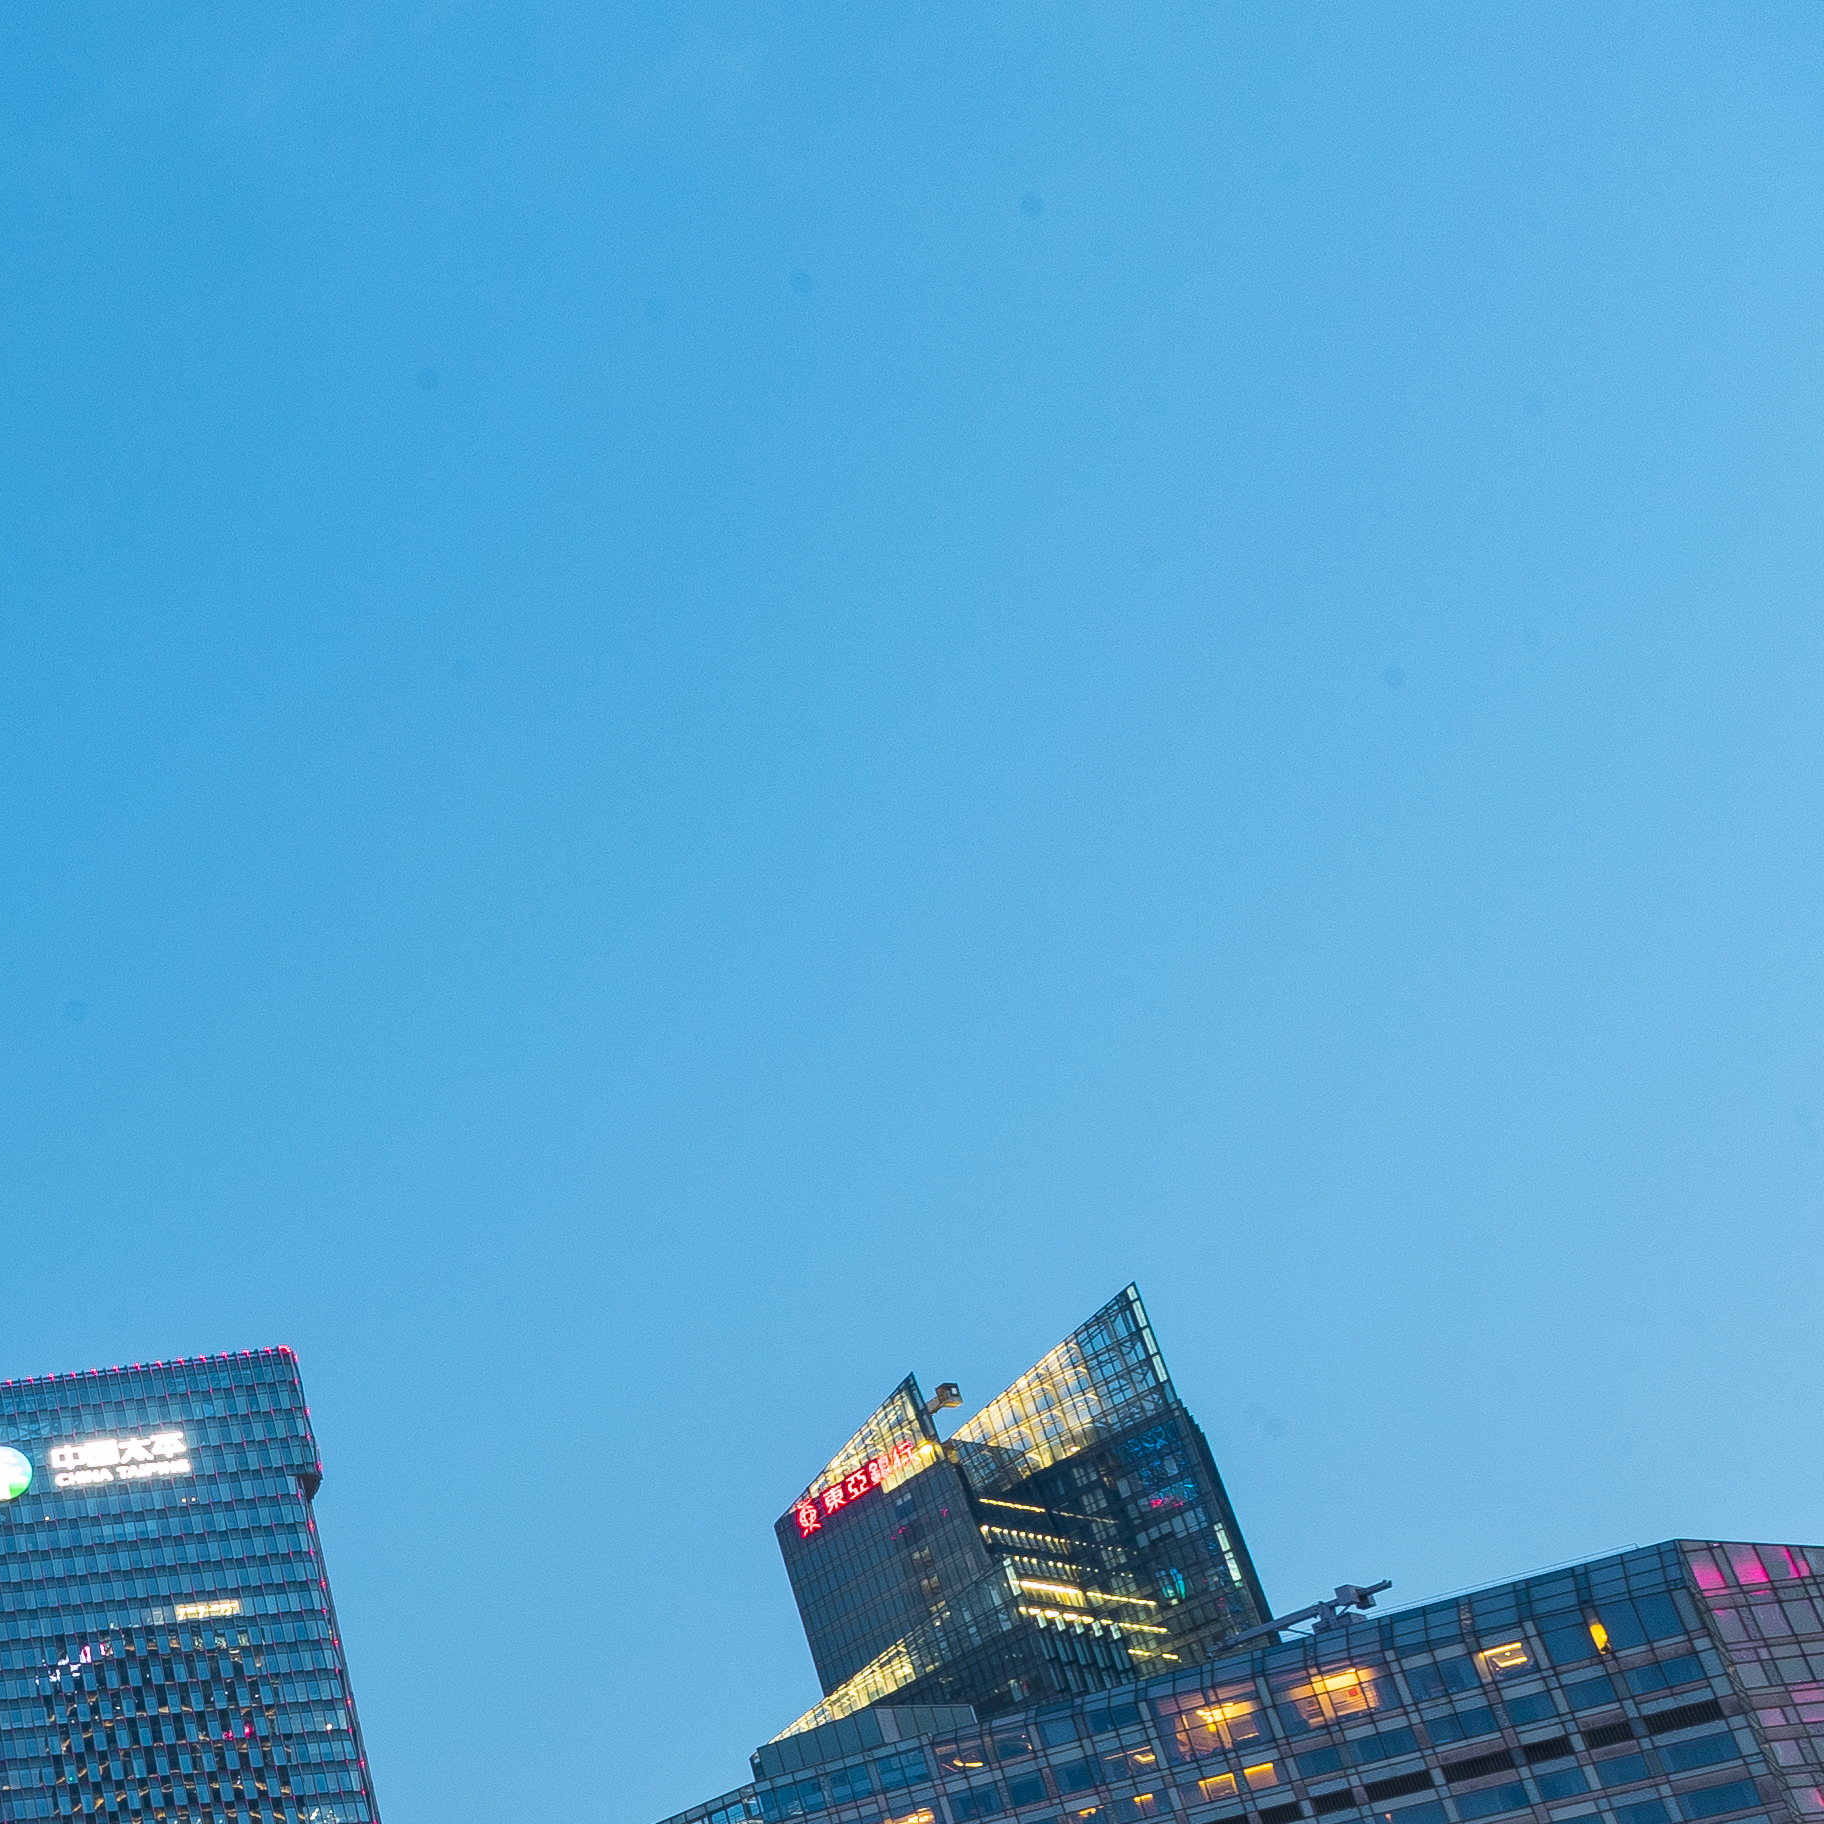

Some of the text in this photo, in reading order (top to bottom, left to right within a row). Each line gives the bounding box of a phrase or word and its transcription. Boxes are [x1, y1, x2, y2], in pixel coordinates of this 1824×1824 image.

[51, 1431, 187, 1470] 中国太平
[54, 1458, 191, 1487] CHINA TAIPING
[821, 1439, 914, 1515] 東亞銀行
